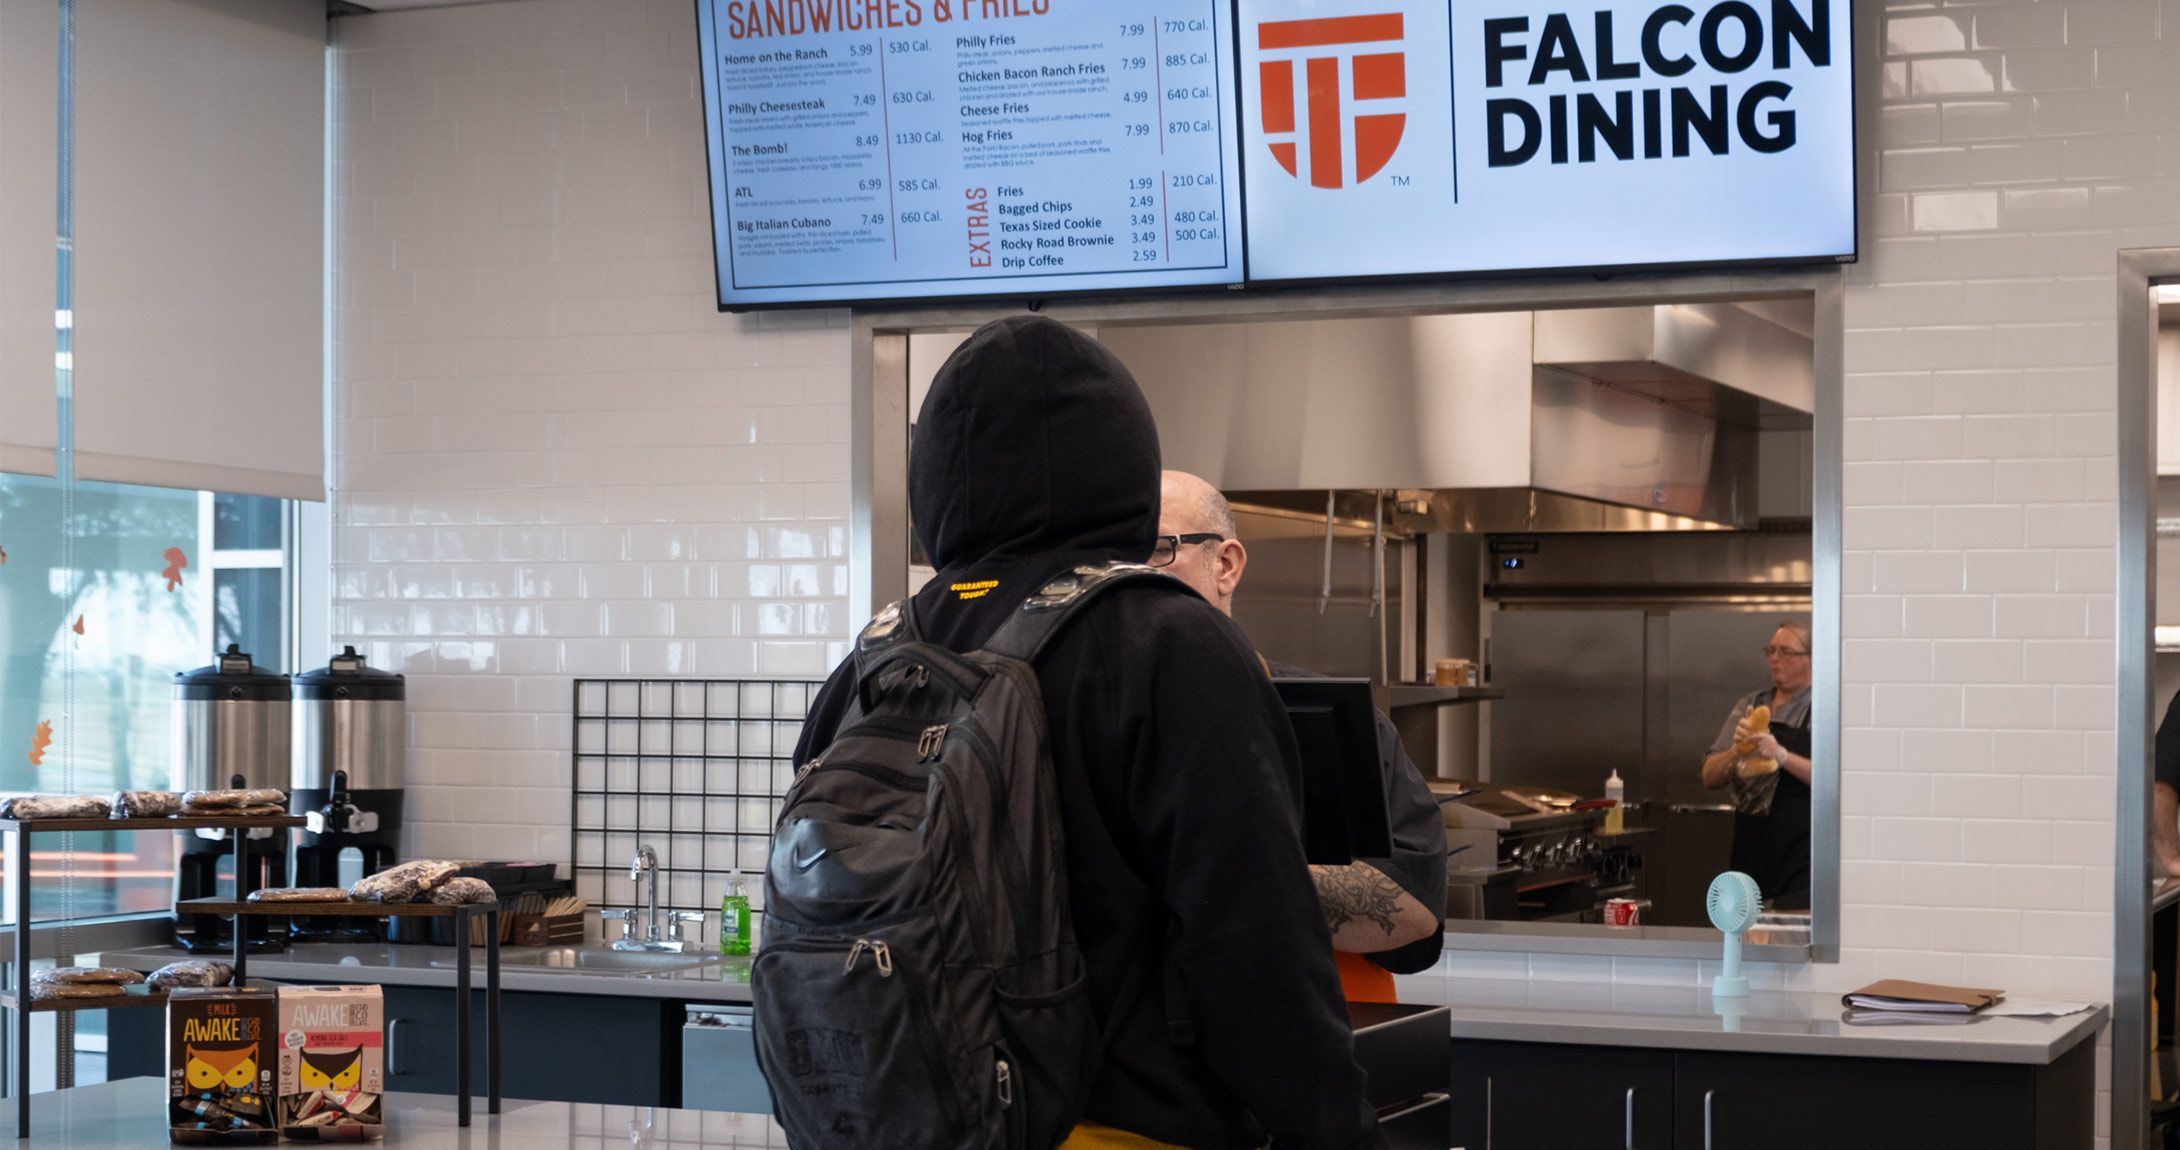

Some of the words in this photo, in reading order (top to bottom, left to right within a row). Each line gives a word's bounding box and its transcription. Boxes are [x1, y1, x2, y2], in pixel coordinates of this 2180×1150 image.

[728, 0, 922, 39] SANDWICHES
[934, 0, 953, 22] &
[1165, 21, 1185, 32] 770
[1189, 19, 1210, 31] Cal.
[1121, 24, 1144, 36] 7.99
[890, 42, 909, 53] 530
[913, 40, 933, 51] Cal.
[957, 36, 986, 48] Philly
[990, 35, 1015, 45] Fries
[1484, 0, 1831, 88] FALCON
[725, 55, 755, 64] Home
[759, 54, 772, 62] on
[775, 51, 792, 61] the
[796, 48, 827, 60] Ranch
[850, 45, 872, 56] 5.99
[1123, 57, 1145, 69] 7.99
[1166, 55, 1186, 66] 885
[1190, 53, 1212, 65] Cal.
[959, 71, 1000, 82] Chicken
[1004, 69, 1037, 79] Bacon
[1042, 65, 1075, 76] Ranch
[1079, 64, 1105, 74] Fries
[854, 95, 875, 105] 7.49
[893, 92, 912, 103] 630
[916, 91, 937, 102] Cal.
[1124, 91, 1147, 102] 4.99
[1168, 89, 1188, 100] 640
[1192, 87, 1214, 99] Cal.
[729, 103, 756, 115] Philly
[760, 99, 825, 112] Cheesesteak
[961, 106, 999, 116] Cheese
[1004, 103, 1029, 113] Fries
[1126, 124, 1149, 135] 7.99
[1169, 122, 1190, 133] 870
[1194, 120, 1215, 132] Cal.
[1488, 80, 1797, 168] DINING
[857, 135, 878, 146] 8.49
[897, 132, 922, 144] 1130
[925, 131, 946, 142] Cal.
[963, 133, 983, 144] Hog
[987, 130, 1012, 140] Fries
[732, 146, 750, 155] The
[754, 143, 787, 155] Bomb!
[859, 179, 881, 190] 6.99
[899, 180, 918, 191] 585
[922, 179, 942, 190] Cal.
[1130, 178, 1152, 189] 1.99
[1173, 175, 1193, 187] 210
[1197, 174, 1219, 185] Cal.
[1391, 176, 1410, 186] TM
[735, 187, 753, 197] ATL
[998, 186, 1023, 196] Fries
[1131, 196, 1153, 207] 2.49
[999, 203, 1038, 216] Bagged
[1043, 202, 1072, 213] Chips
[862, 214, 884, 224] 7.49
[901, 212, 920, 223] 660
[924, 211, 945, 222] Cal.
[1132, 214, 1154, 225] 3.49
[1175, 212, 1195, 222] 480
[1199, 210, 1221, 222] Cal.
[738, 221, 753, 233] Big
[756, 220, 789, 230] Italian
[791, 218, 831, 228] Cubano
[966, 187, 992, 268] EXTRAS
[1000, 223, 1030, 232] Texas
[1033, 219, 1060, 231] Sized
[1064, 218, 1101, 229] Cookie
[1133, 232, 1155, 243] 3.49
[1176, 229, 1196, 241] 500
[1200, 228, 1222, 239] Cal.
[1001, 239, 1032, 251] Rocky
[1037, 237, 1064, 248] Road
[1068, 237, 1114, 246] Brownie
[1003, 257, 1025, 269] Drip
[1029, 255, 1063, 266] Coffee
[1133, 250, 1156, 261] 2.59
[950, 580, 999, 591] GUARANTEED
[293, 1004, 350, 1028] AWAKE
[184, 1018, 241, 1042] AWAKE
